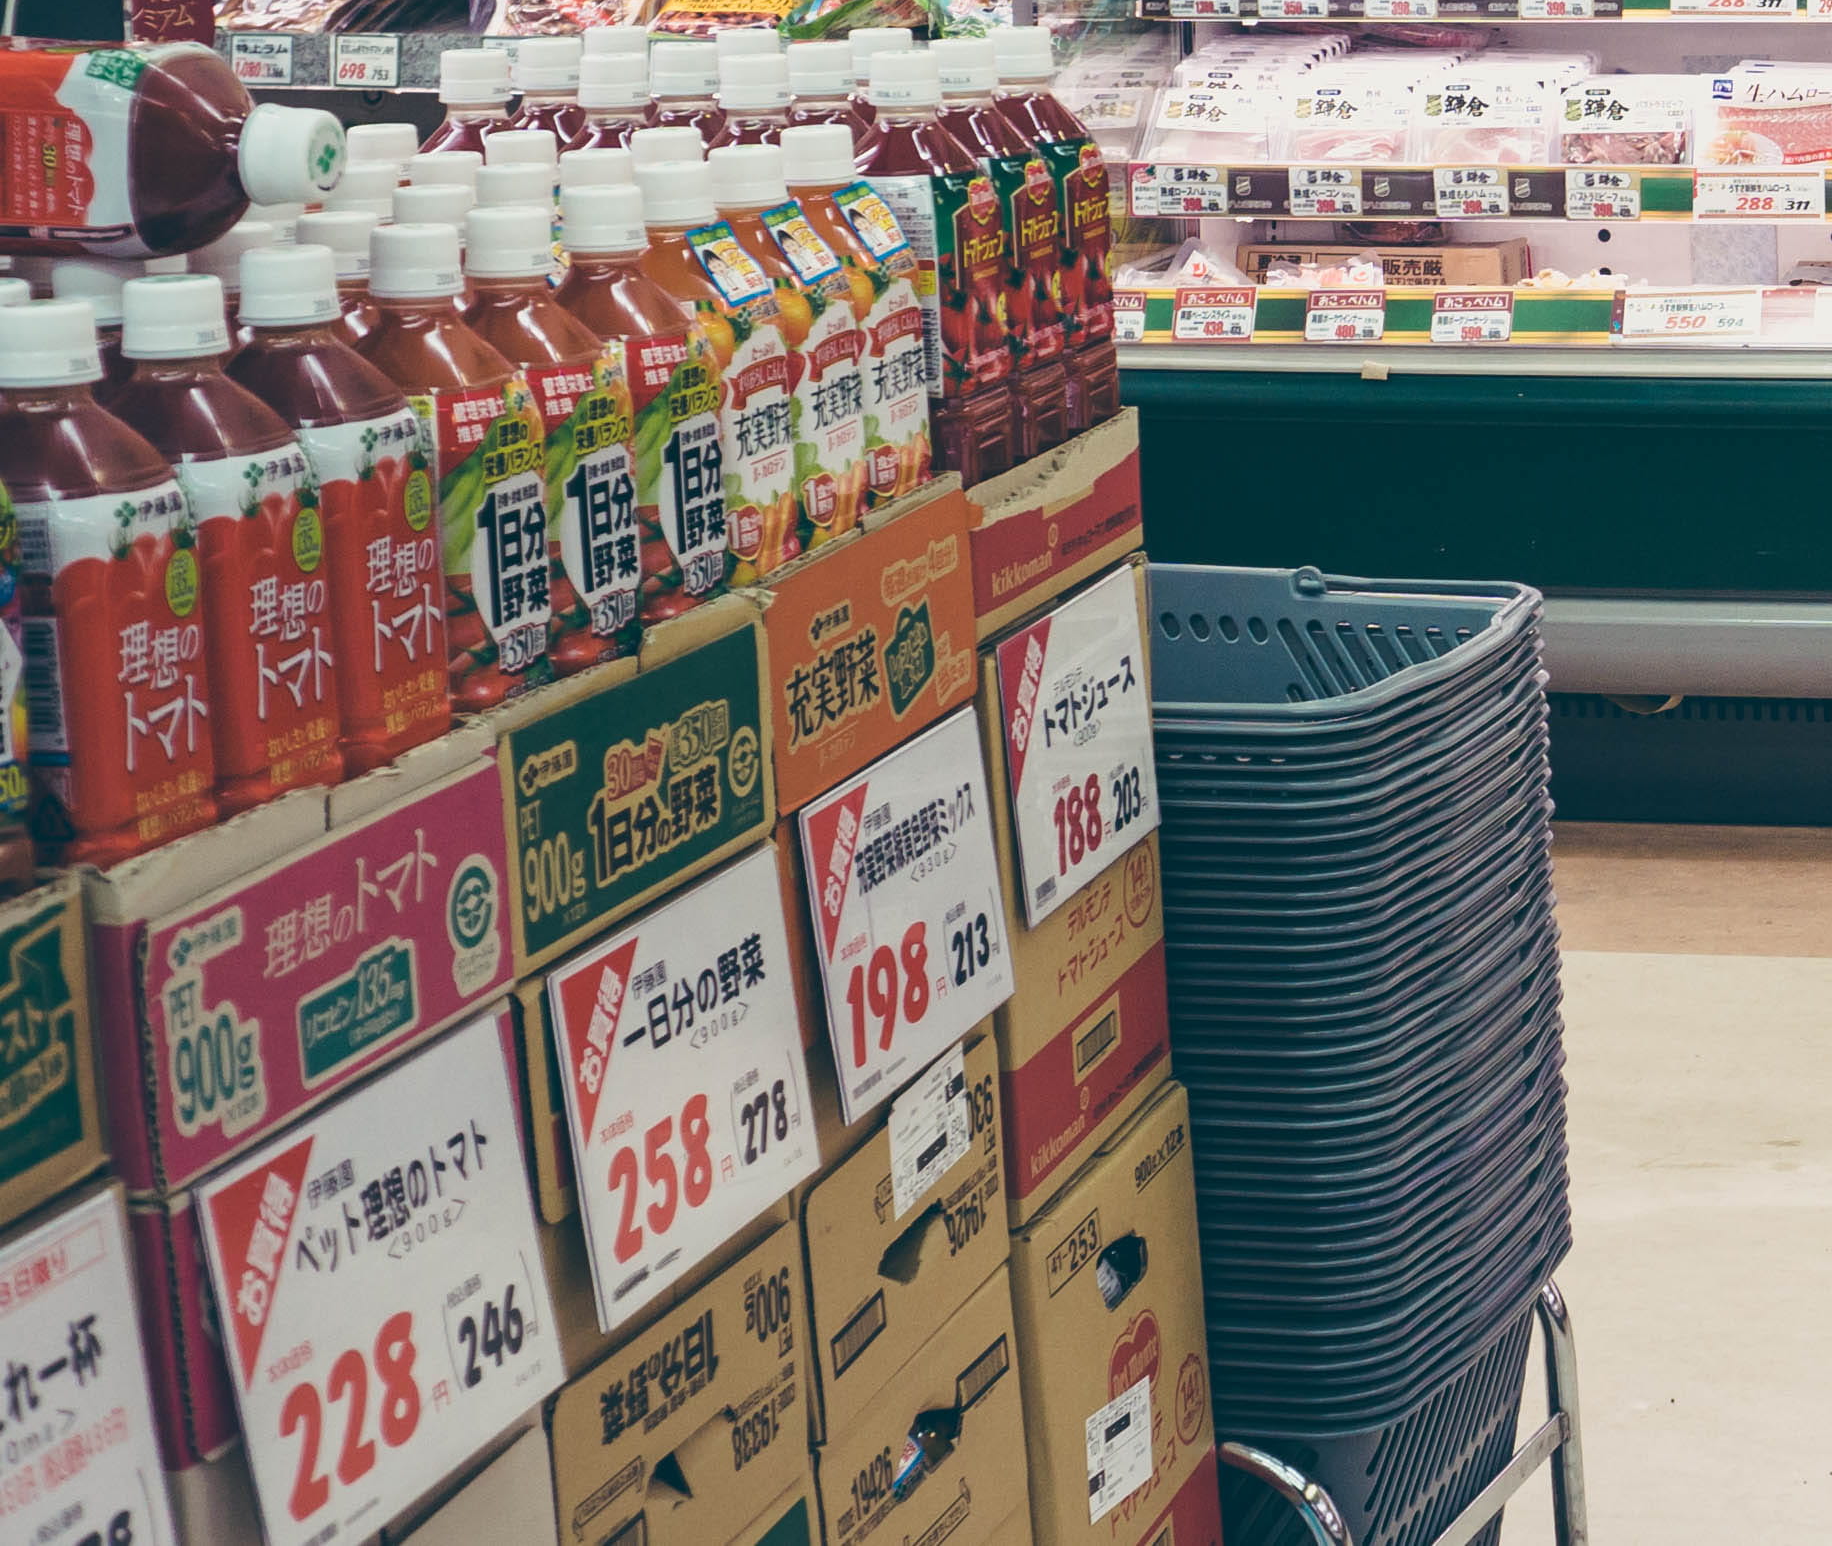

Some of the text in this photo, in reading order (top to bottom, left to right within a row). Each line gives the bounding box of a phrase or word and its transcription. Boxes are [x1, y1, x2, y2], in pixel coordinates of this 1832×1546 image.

[339, 61, 366, 80] 698
[1665, 314, 1706, 329] 550
[249, 574, 326, 642] 理想の
[593, 534, 638, 588] 野菜
[992, 544, 1055, 599] kikkoman
[117, 622, 199, 687] 理想の
[255, 626, 333, 720] トマト
[371, 582, 442, 673] トマト
[124, 674, 208, 772] トマト
[786, 632, 882, 754] 充実野菜
[1041, 655, 1137, 749] トマトジュース
[1053, 772, 1144, 876] 188 203
[262, 827, 438, 980] 理想のトマト
[523, 831, 587, 924] 900g
[622, 932, 766, 1050] 一日分の野菜
[845, 912, 992, 1069] 198 213
[607, 1079, 789, 1264] 258 278
[1030, 1111, 1087, 1179] kikkoman
[294, 1118, 488, 1273] ペット理想のトマト
[279, 1283, 525, 1522] 228 246
